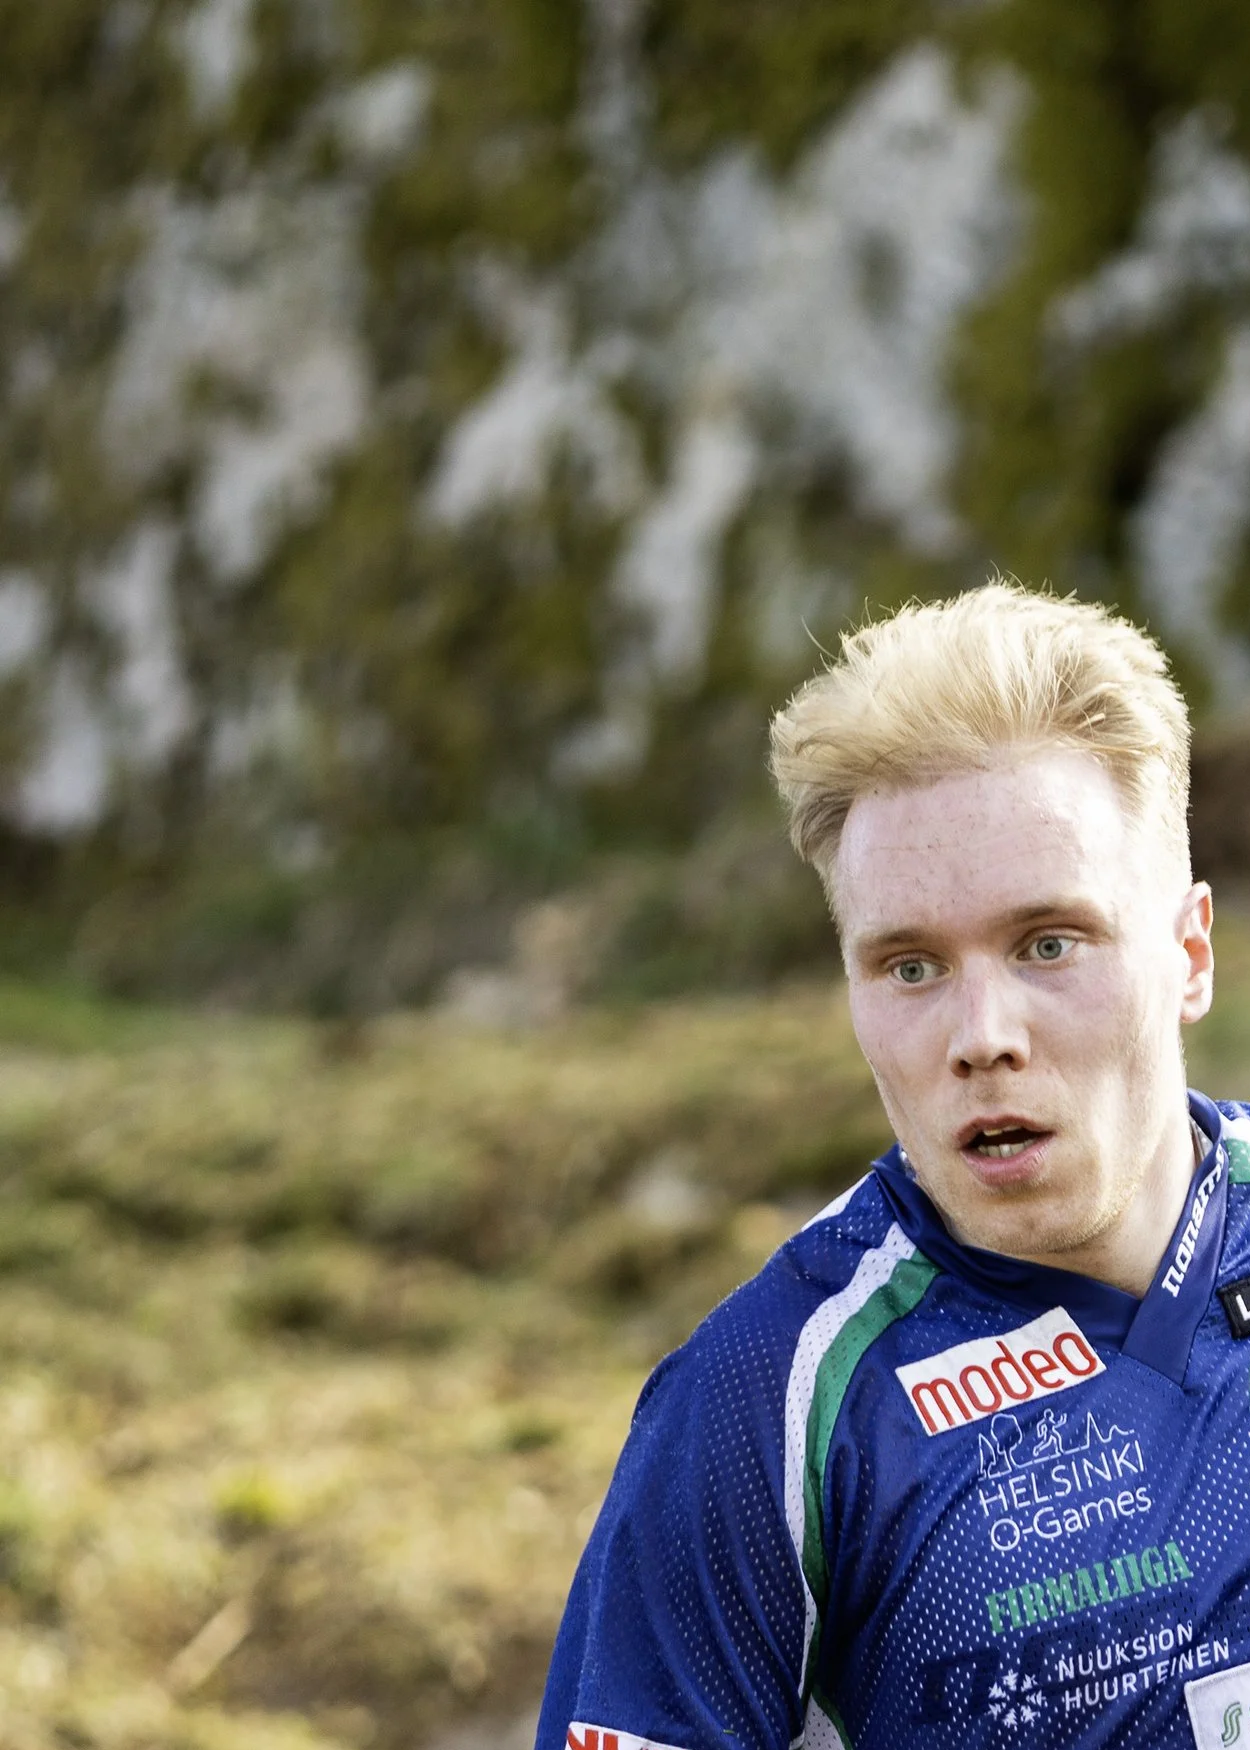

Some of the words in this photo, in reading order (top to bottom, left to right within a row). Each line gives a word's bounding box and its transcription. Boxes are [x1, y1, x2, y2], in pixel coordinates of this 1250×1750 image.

[911, 1332, 1098, 1434] modeo
[977, 1440, 1145, 1517] HELSINKI
[990, 1486, 1151, 1551] O-Games
[1057, 1619, 1194, 1682] NUUKSION
[1063, 1637, 1230, 1711] HUURTEINEN
